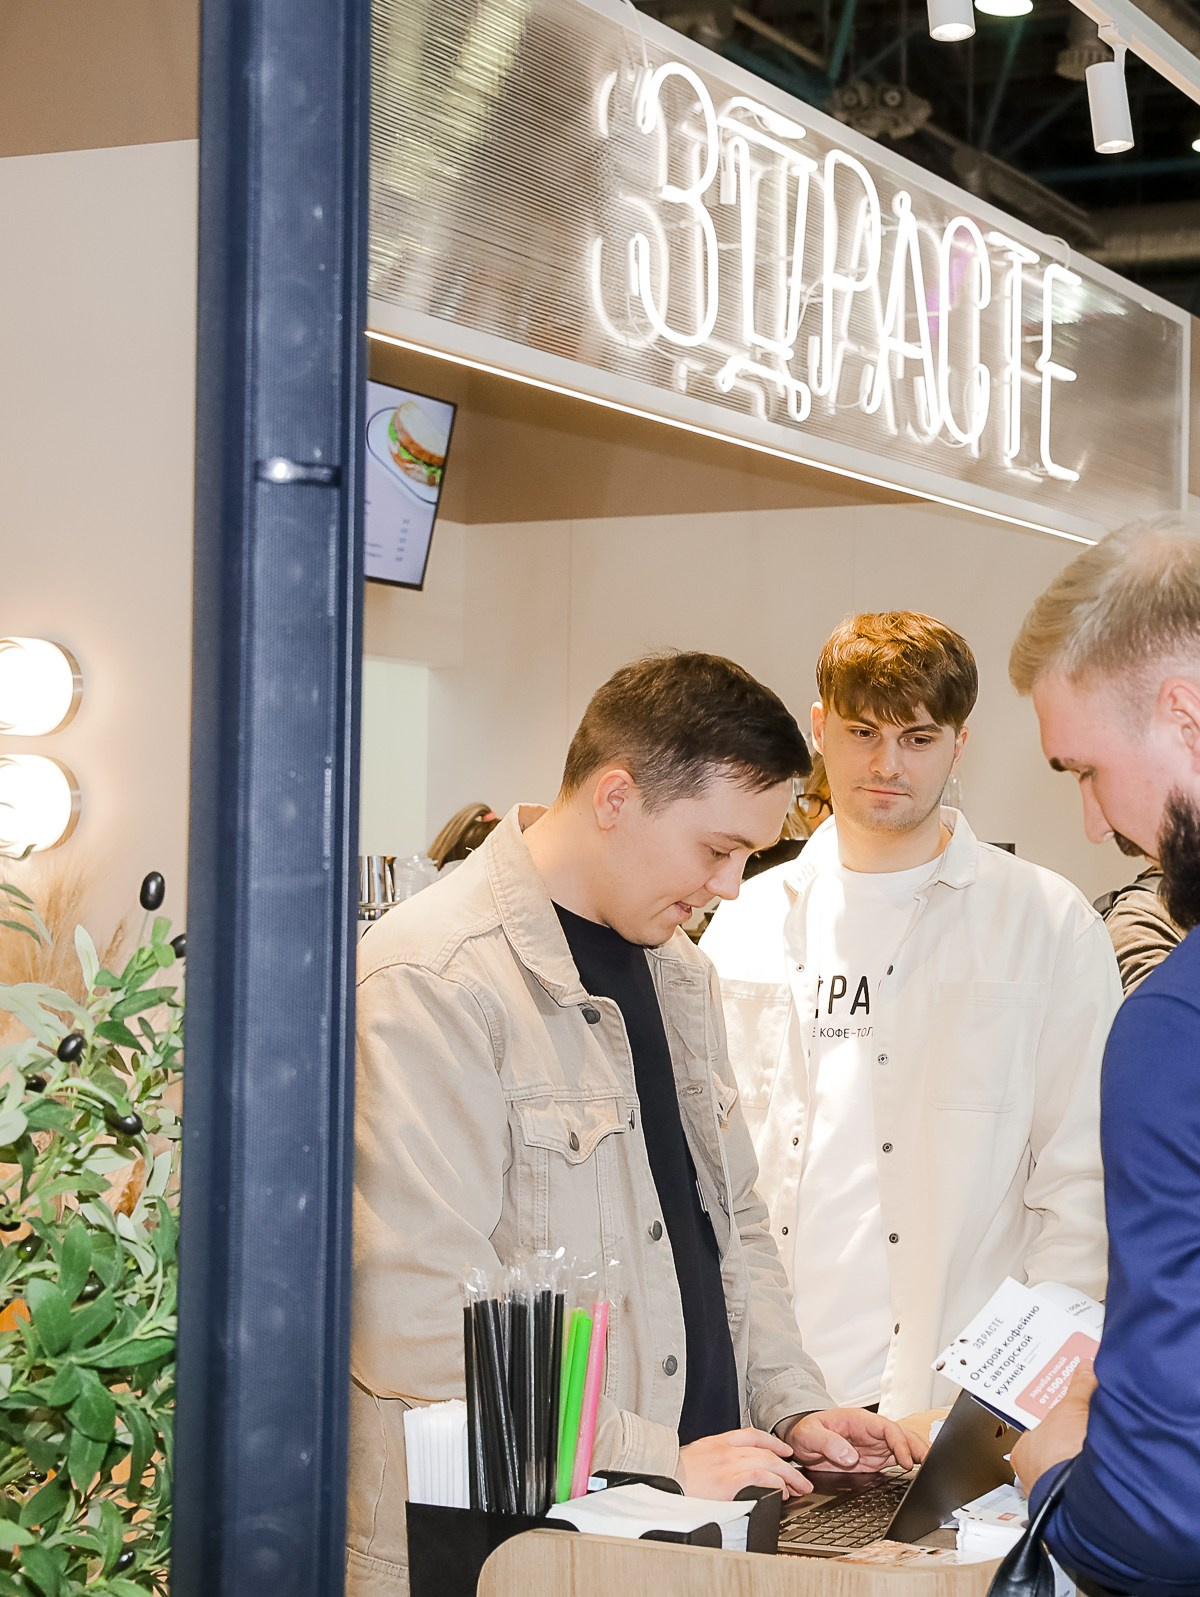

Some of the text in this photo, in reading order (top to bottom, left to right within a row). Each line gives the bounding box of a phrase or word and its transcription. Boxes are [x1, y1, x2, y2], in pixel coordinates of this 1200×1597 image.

[970, 1347, 1004, 1381] Открой
[1002, 1304, 1040, 1348] кофейню
[973, 1316, 1004, 1350] ЗДРАСТЕ
[990, 1334, 1034, 1382] авторской
[995, 1363, 1027, 1396] кухней
[1039, 1393, 1049, 1405] от
